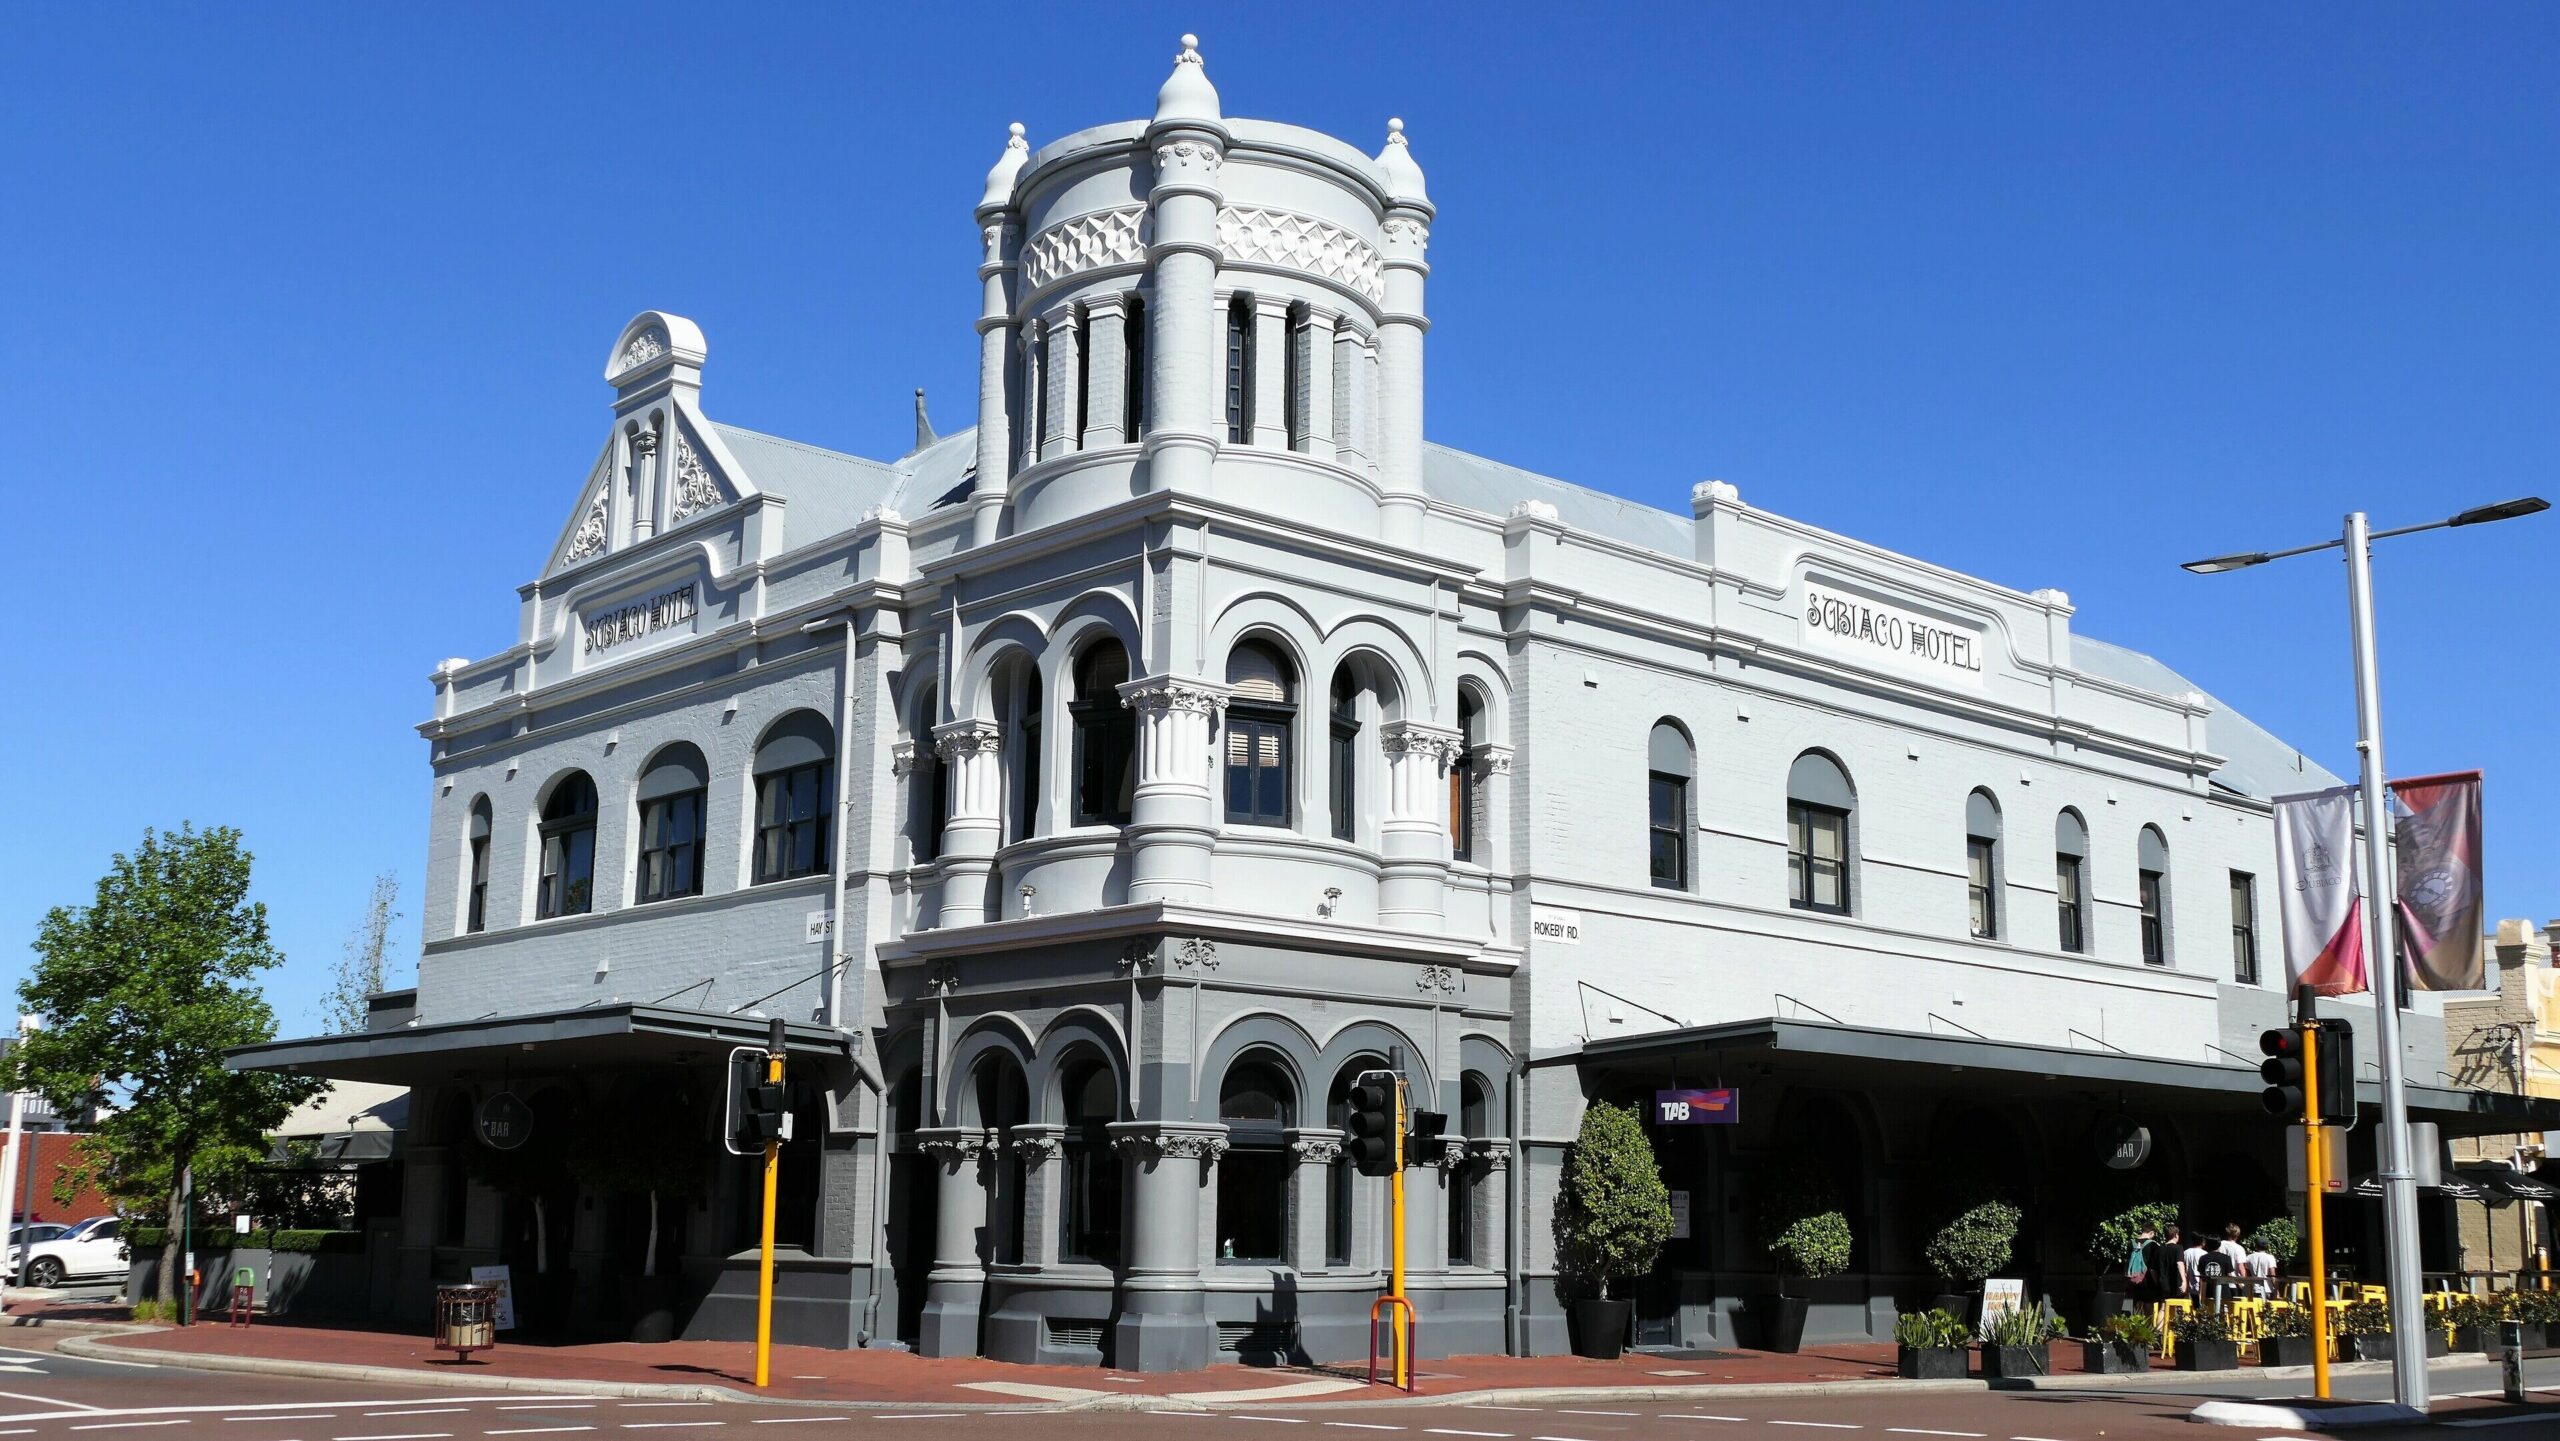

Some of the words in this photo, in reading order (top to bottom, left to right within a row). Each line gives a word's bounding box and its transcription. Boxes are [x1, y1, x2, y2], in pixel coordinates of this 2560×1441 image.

[585, 603, 647, 652] SUBIACO
[650, 581, 698, 632] HOTEL
[1807, 593, 1902, 650] SUBIACO
[1908, 621, 1980, 672] HOTEL
[810, 922, 823, 936] HAY
[825, 920, 835, 934] ST
[1534, 921, 1564, 938] ROKEBY
[1661, 1102, 1690, 1121] TAB
[491, 1121, 509, 1137] BAR
[2117, 1143, 2134, 1158] BAR
